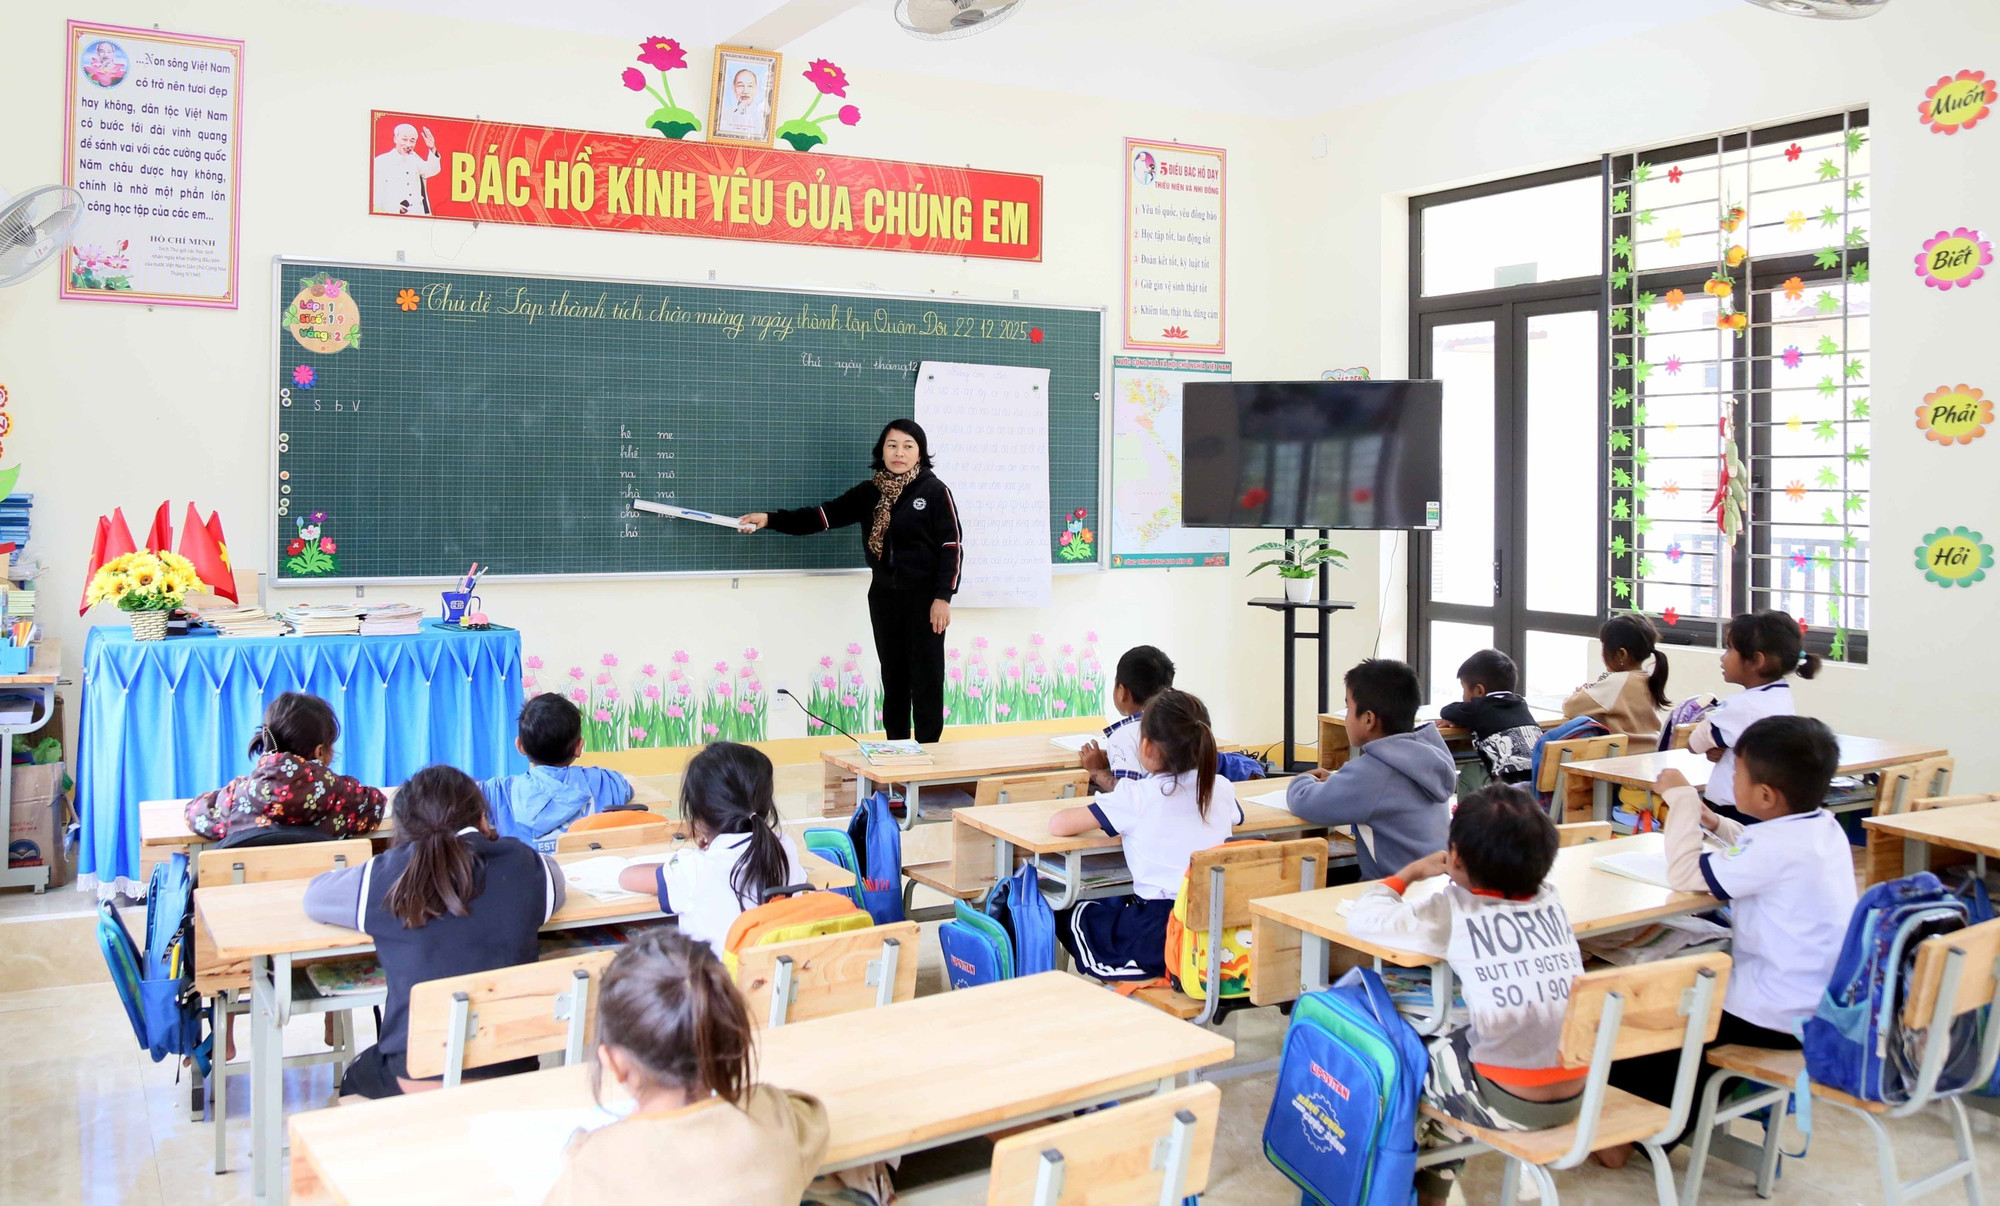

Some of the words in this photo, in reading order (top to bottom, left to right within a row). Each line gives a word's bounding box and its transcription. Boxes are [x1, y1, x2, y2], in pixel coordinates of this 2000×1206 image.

[168, 59, 188, 72] sông
[191, 60, 208, 74] Việt
[210, 64, 230, 74] Nam
[136, 78, 148, 88] có
[151, 78, 164, 90] trở
[168, 82, 186, 92] nên
[188, 84, 206, 94] tươi
[208, 86, 228, 98] đẹp
[82, 97, 98, 110] hay
[104, 99, 136, 114] không,
[142, 104, 159, 114] dân
[164, 105, 180, 119] tộc
[185, 107, 202, 121] Việt
[208, 110, 228, 122] Nam
[1930, 85, 1986, 118] Muốn
[80, 117, 93, 128] có
[100, 120, 124, 132] bước
[131, 122, 144, 133] tới
[150, 124, 166, 136] đài
[172, 127, 191, 138] vinh
[198, 131, 228, 144] quang
[80, 135, 92, 149] để
[95, 140, 117, 152] sánh
[120, 142, 134, 153] vai
[137, 143, 150, 154] với
[153, 145, 170, 156] các
[173, 147, 201, 162] cường
[204, 148, 227, 162] quốc
[80, 158, 102, 170] Năm
[109, 162, 133, 173] châu
[140, 164, 164, 178] được
[171, 167, 188, 180] hay
[194, 168, 226, 184] không,
[1160, 162, 1168, 176] 5
[80, 180, 106, 192] chính
[114, 182, 122, 192] là
[130, 184, 148, 195] nhờ
[155, 186, 173, 200] một
[180, 186, 204, 200] phần
[211, 190, 226, 201] lớn
[451, 144, 531, 207] BÁC
[544, 146, 594, 212] HỒ
[608, 158, 696, 220] KÍNH
[708, 166, 775, 226] YÊU
[785, 168, 854, 232] CỦA
[864, 184, 973, 241] CHÚNG
[982, 199, 1029, 246] EM
[88, 200, 110, 215] công
[114, 202, 131, 216] học
[134, 204, 150, 218] tập
[152, 204, 169, 217] của
[172, 208, 189, 218] các
[192, 210, 214, 220] em...
[150, 234, 166, 243] HỒ
[168, 236, 186, 244] CHÍ
[189, 238, 216, 247] MINH
[1932, 246, 1972, 270] Biết
[329, 303, 334, 312] 1
[421, 282, 467, 312] Chủ
[550, 290, 606, 319] thành
[612, 294, 645, 320] tích
[649, 296, 691, 322] chào
[695, 307, 745, 340] mừng
[751, 312, 794, 342] ngày
[798, 304, 843, 331] thành
[845, 307, 872, 340] lập
[334, 332, 341, 342] 2
[834, 360, 862, 378] ngày
[1133, 358, 1147, 368] CỘNG
[1206, 362, 1217, 372] VIỆT
[1218, 363, 1230, 371] NAM
[1931, 403, 1978, 426] Phải
[620, 471, 636, 479] na
[658, 470, 675, 479] mô
[620, 484, 640, 498] nhà
[620, 524, 638, 538] chó
[1934, 547, 1970, 566] Hỏi
[538, 841, 556, 852] EST
[1475, 963, 1508, 982] BUT
[1514, 960, 1530, 977] IT
[1536, 981, 1544, 1002] I
[1310, 1060, 1350, 1102] LIPOVITAN
